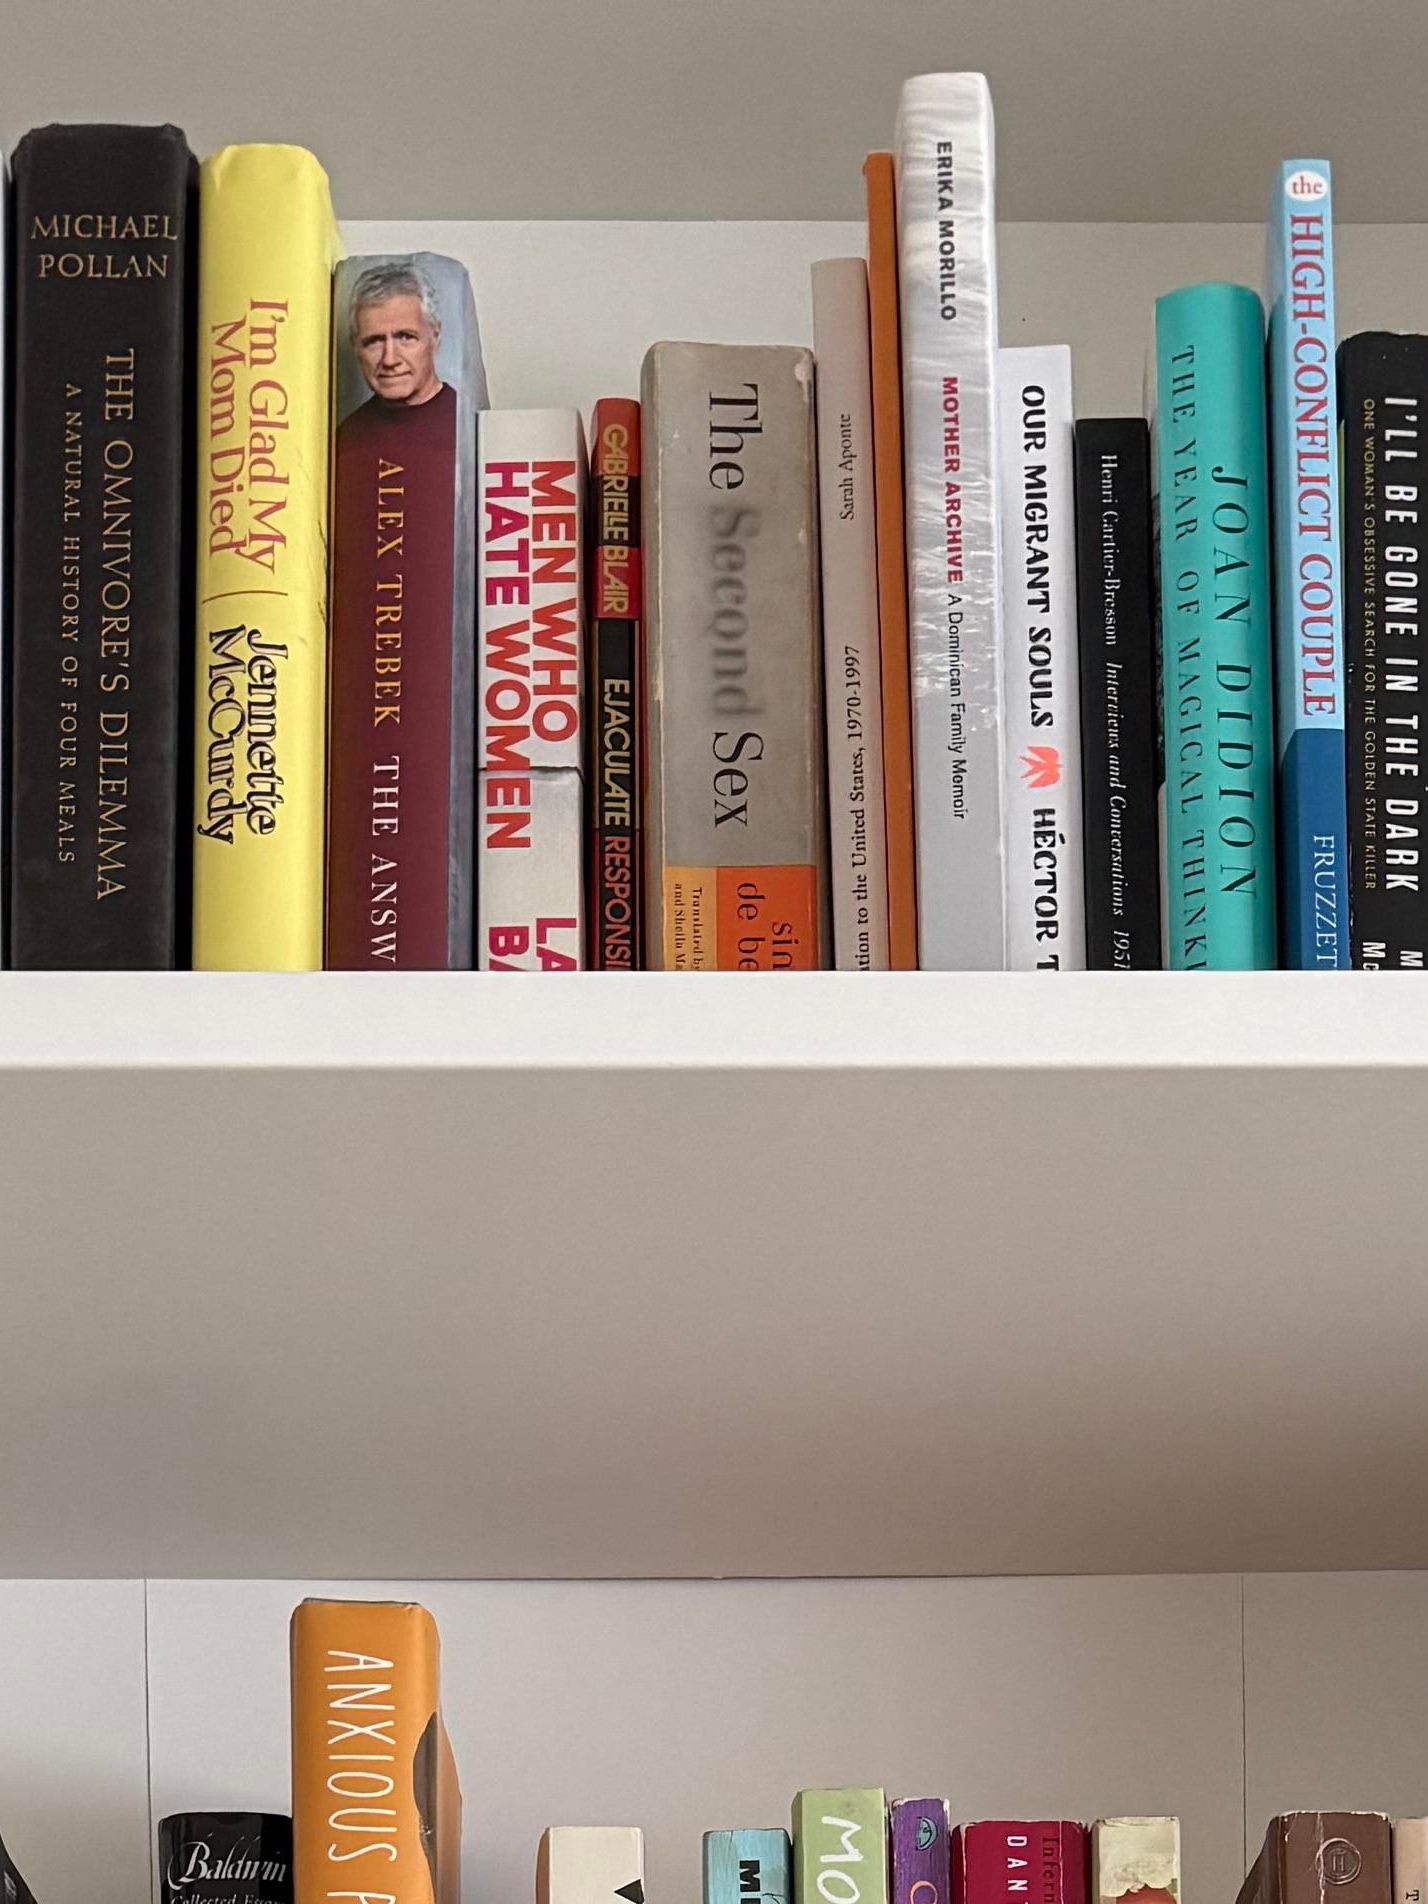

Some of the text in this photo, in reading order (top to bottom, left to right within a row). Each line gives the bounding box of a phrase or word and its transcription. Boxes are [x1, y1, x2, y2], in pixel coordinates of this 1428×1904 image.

[32, 215, 178, 240] MICHAEL
[40, 254, 167, 278] POLLAN
[937, 142, 956, 320] ERIKA MORILLO
[1292, 176, 1322, 194] the
[838, 414, 854, 520] Sarah Aponte
[1290, 215, 1337, 717] HIGH-CONFLICT COUPLE
[97, 348, 134, 899] THE OMNIVORE'S DILEMMA
[1212, 467, 1256, 896] JOAN DIDION
[197, 626, 240, 845] McCurdy
[245, 630, 288, 834] Jennette
[325, 1651, 397, 1861] ANXIOUS
